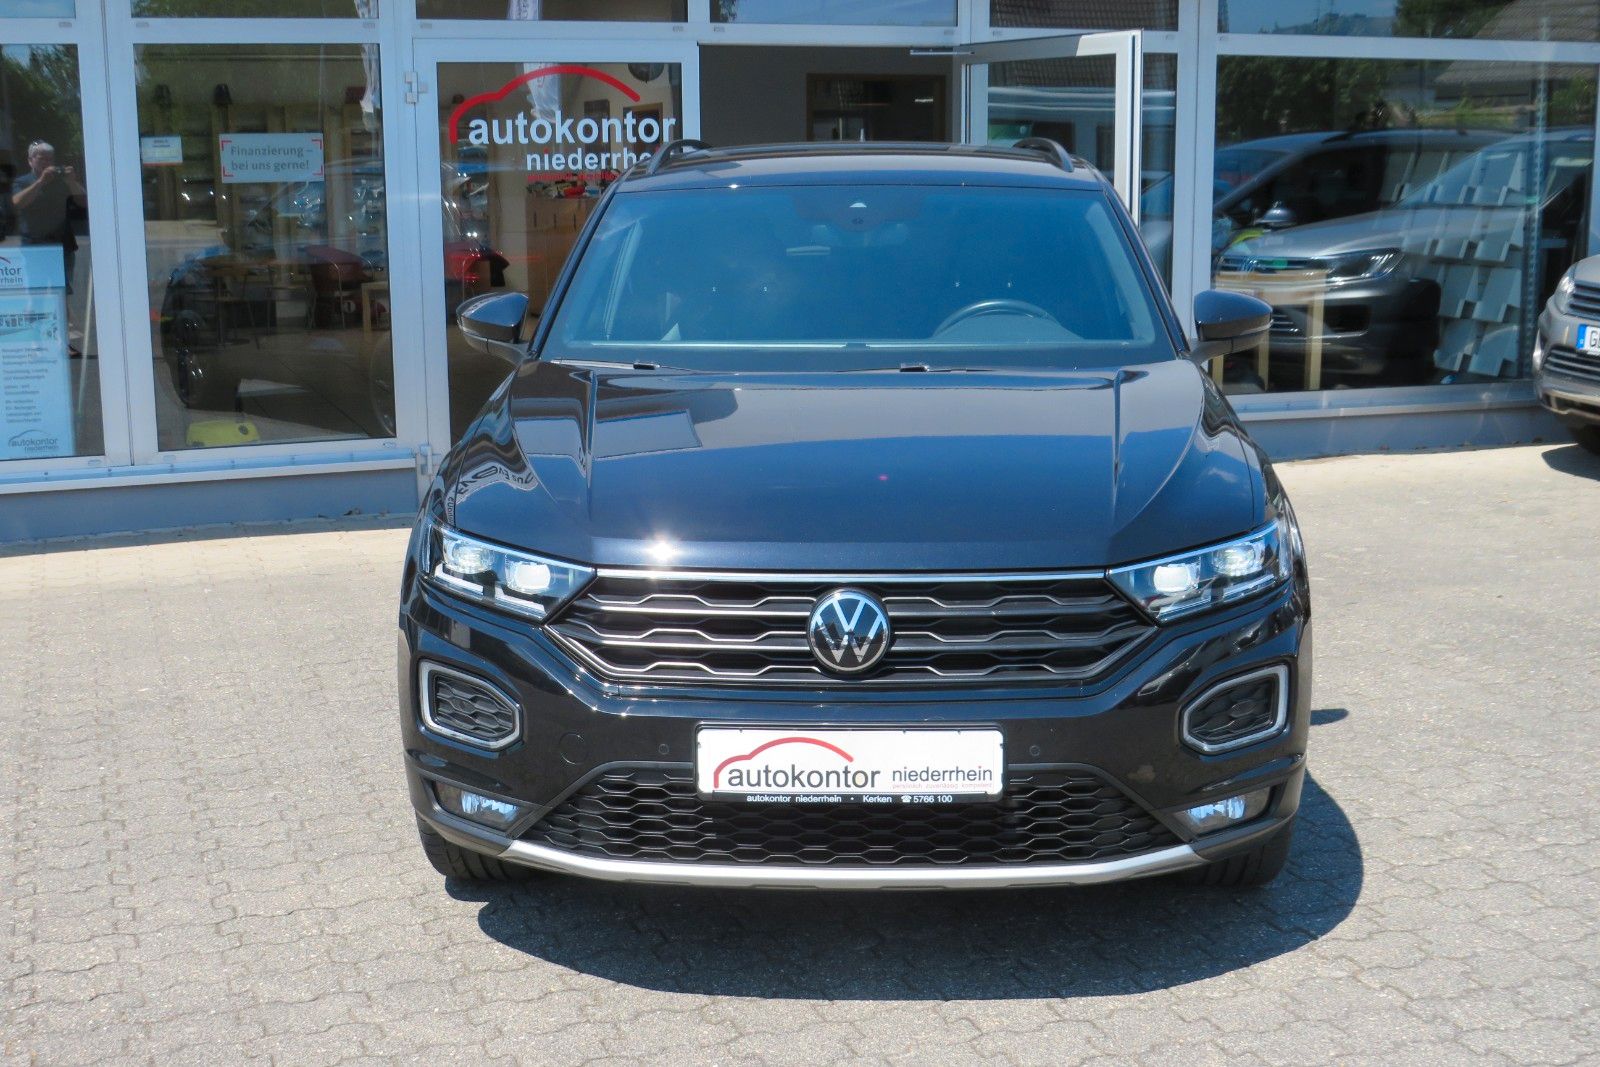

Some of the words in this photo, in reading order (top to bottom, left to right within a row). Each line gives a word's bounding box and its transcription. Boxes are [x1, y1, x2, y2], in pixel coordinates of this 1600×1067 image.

[468, 109, 676, 145] autokontor
[230, 145, 304, 158] Finanzierung
[526, 147, 660, 171] niederrhe
[231, 160, 249, 171] bei
[251, 161, 272, 171] uns
[273, 160, 310, 173] gerne!
[727, 764, 881, 789] autokontor
[892, 766, 993, 782] niederrhein
[746, 794, 792, 803] autokontor
[795, 794, 842, 803] niederrhein
[863, 794, 893, 803] Kerken
[913, 794, 935, 803] 5766
[937, 794, 953, 803] 100
